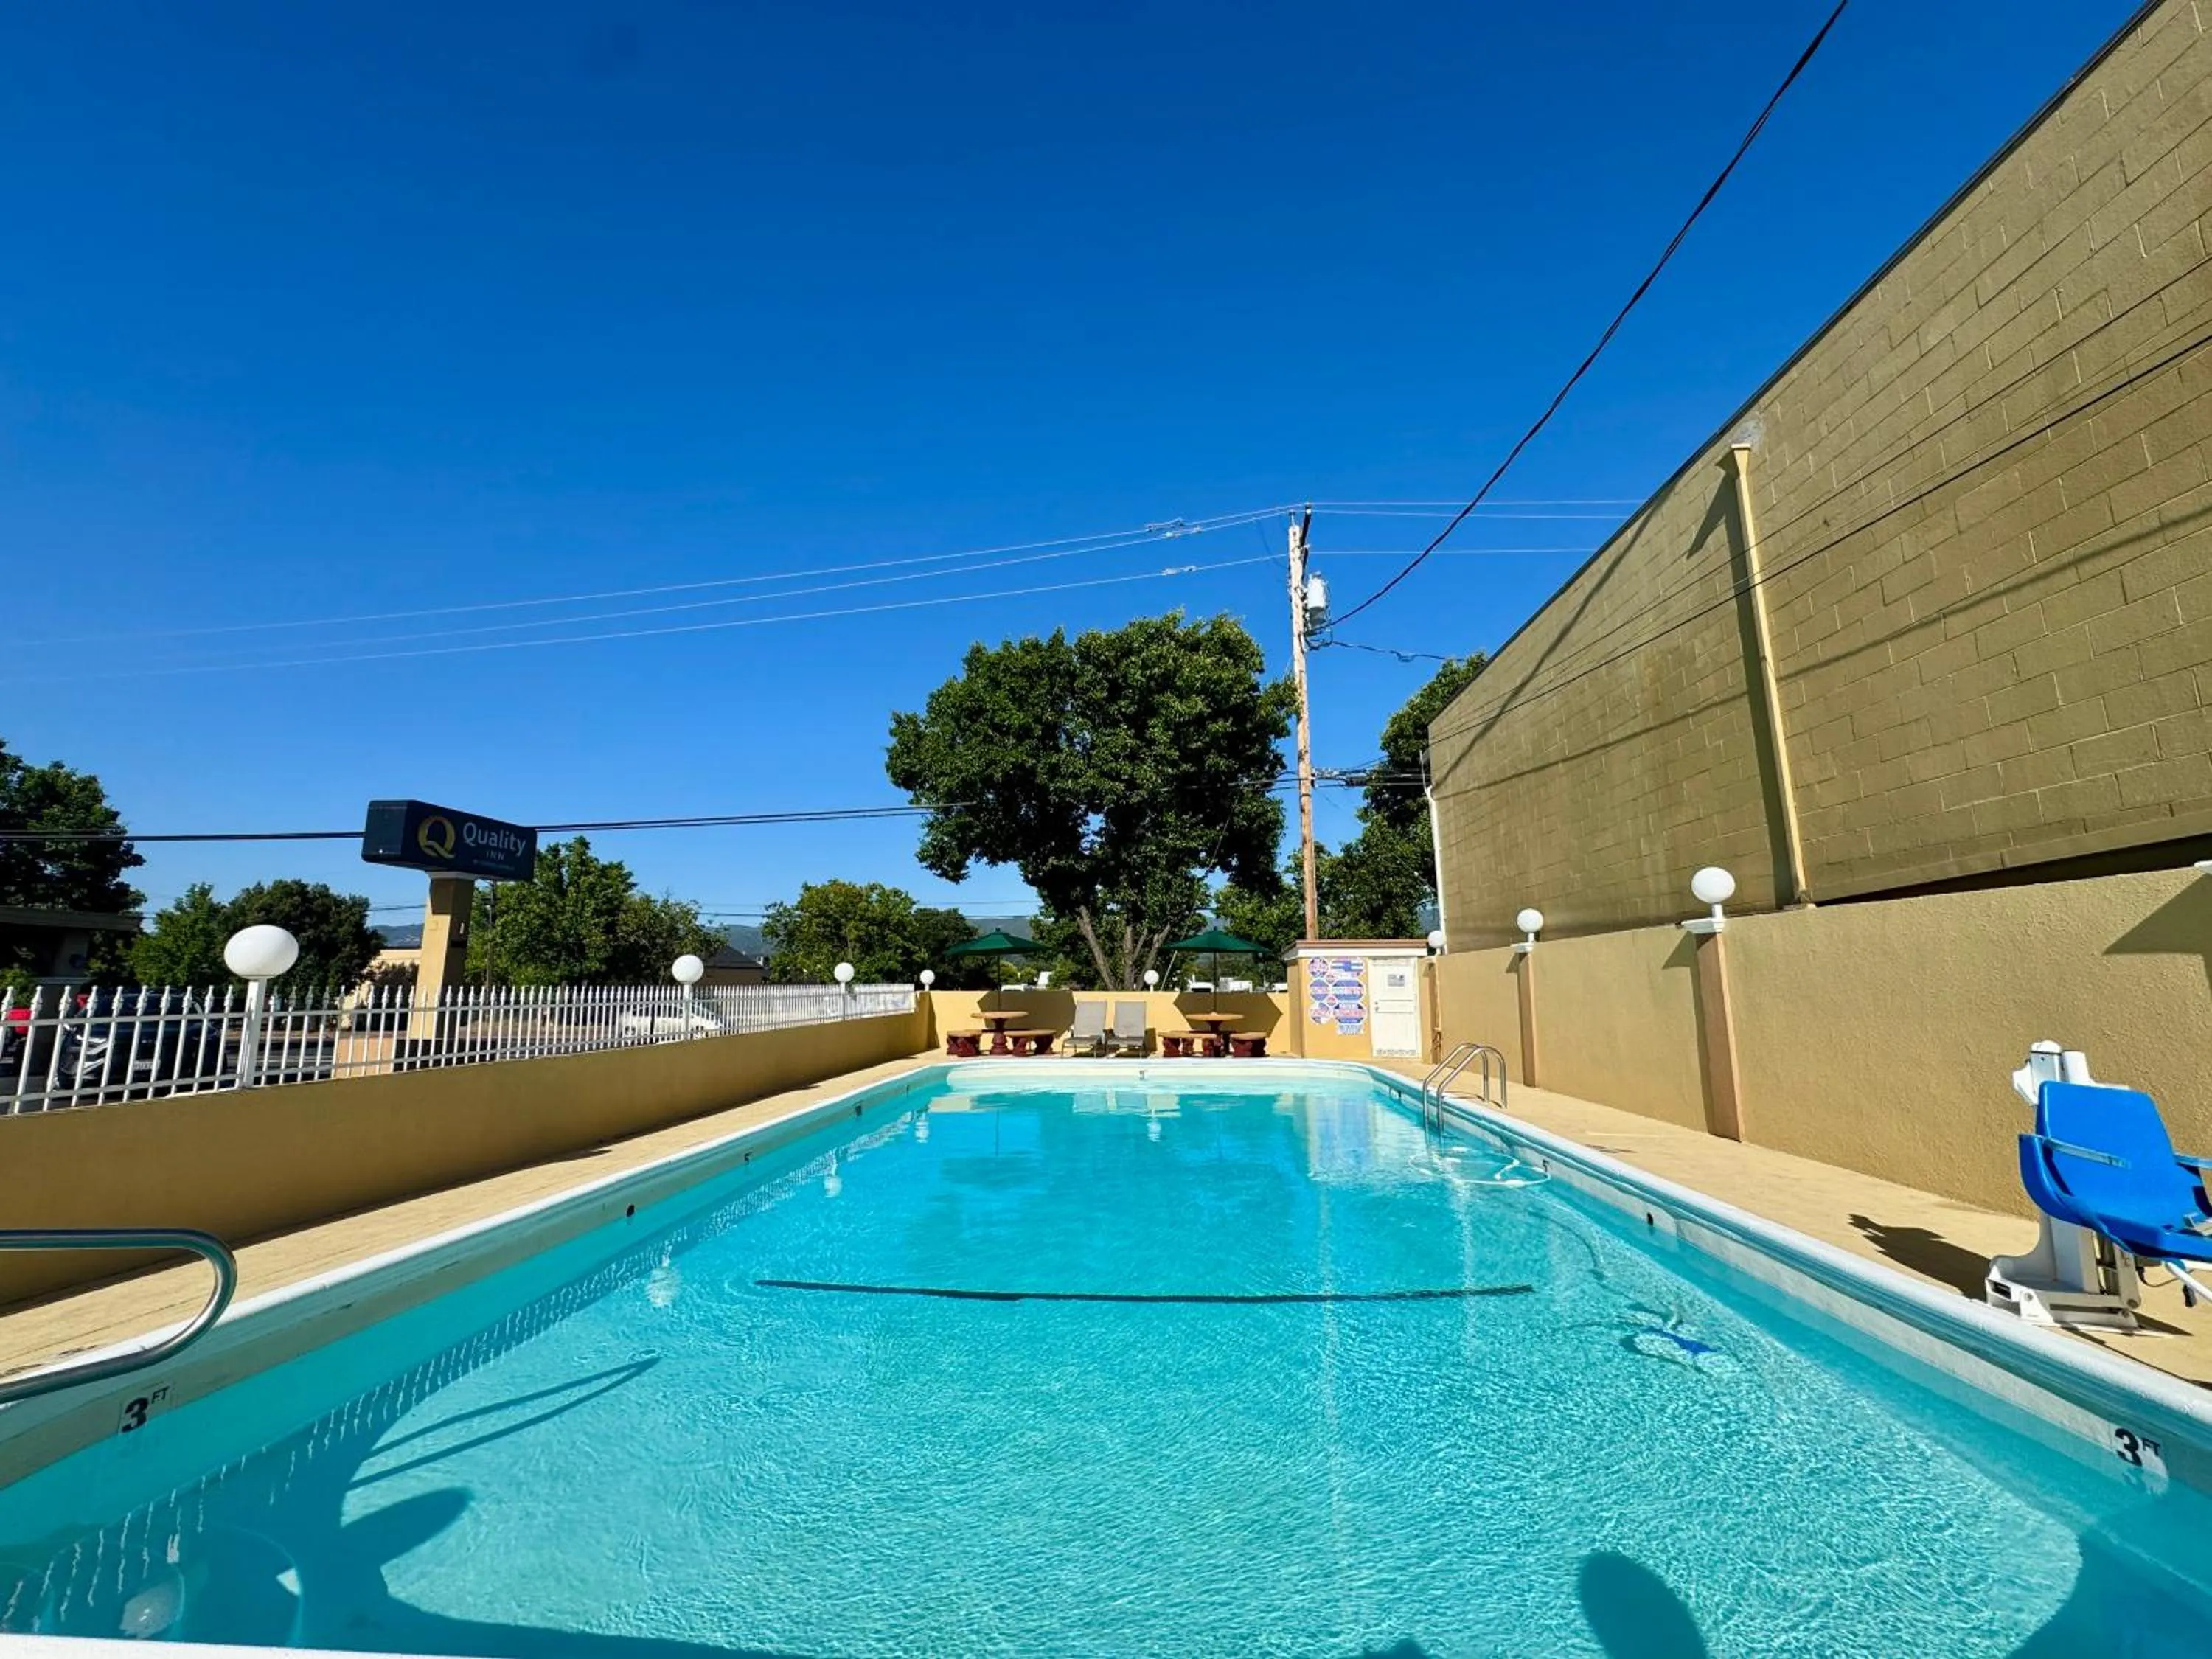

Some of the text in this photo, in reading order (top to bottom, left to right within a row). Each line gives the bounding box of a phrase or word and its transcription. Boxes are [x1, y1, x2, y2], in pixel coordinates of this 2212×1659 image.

[417, 816, 456, 859] Q
[462, 821, 526, 857] Quality
[485, 849, 506, 861] INN
[122, 1385, 170, 1433] 3 FT
[2115, 1427, 2161, 1467] 3 FT
